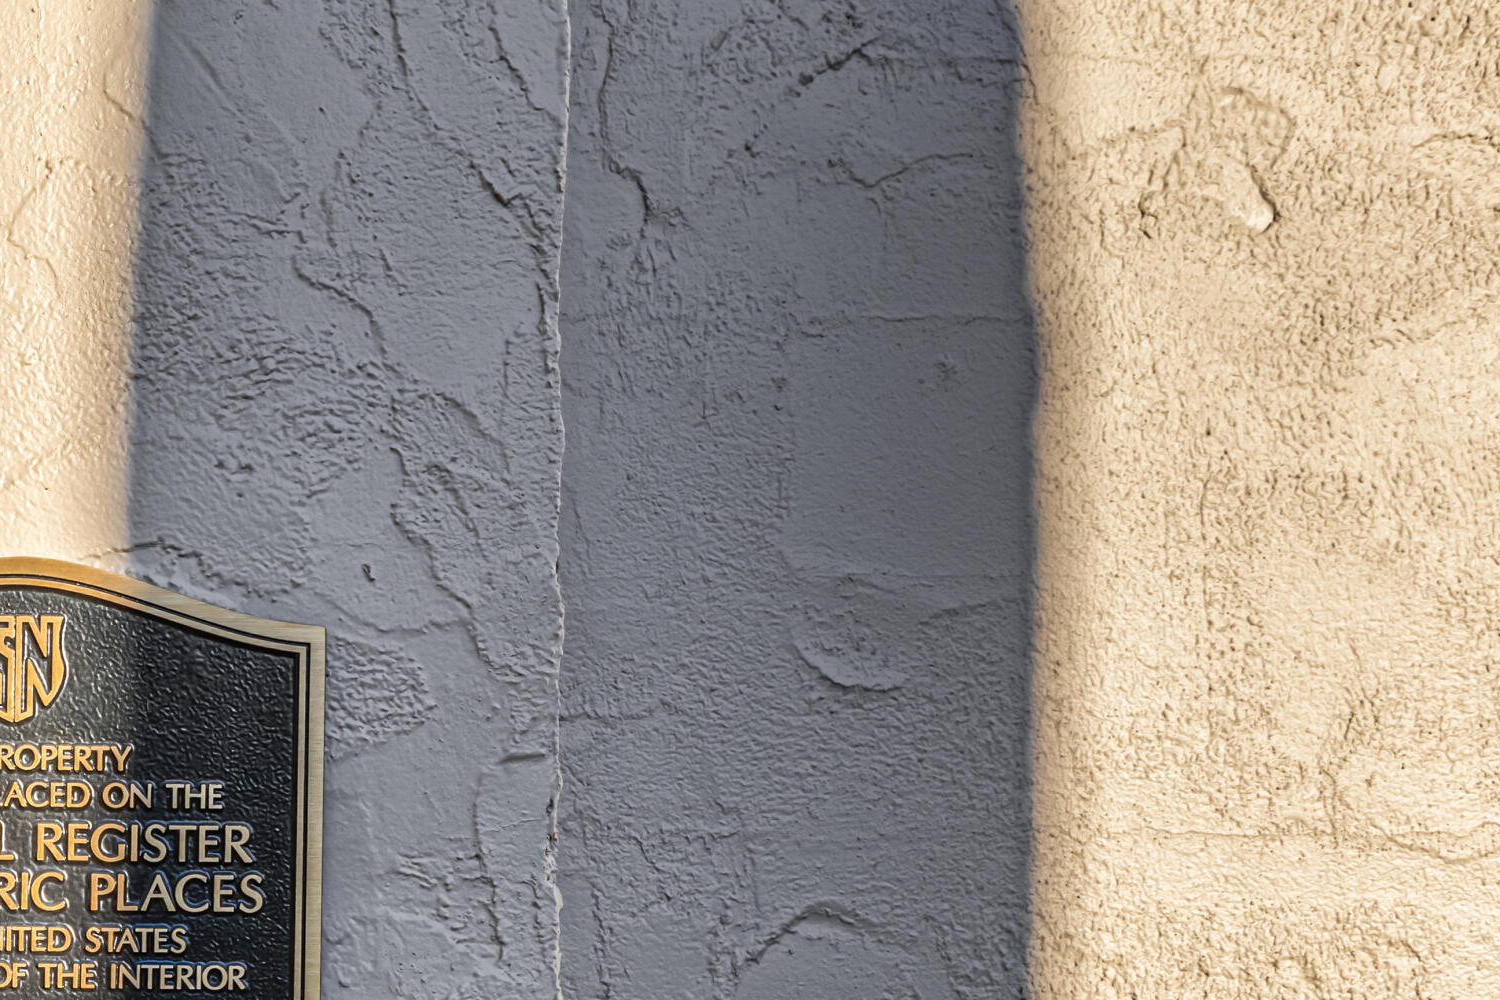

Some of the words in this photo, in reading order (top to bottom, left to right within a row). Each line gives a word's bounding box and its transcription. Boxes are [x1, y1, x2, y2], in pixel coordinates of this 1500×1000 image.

[102, 783, 157, 809] ON
[165, 783, 223, 810] THE
[37, 823, 252, 863] REGISTER
[90, 873, 263, 913] PLACES
[85, 927, 186, 953] STATES
[39, 962, 96, 989] THE
[110, 962, 245, 991] INTERIOR
